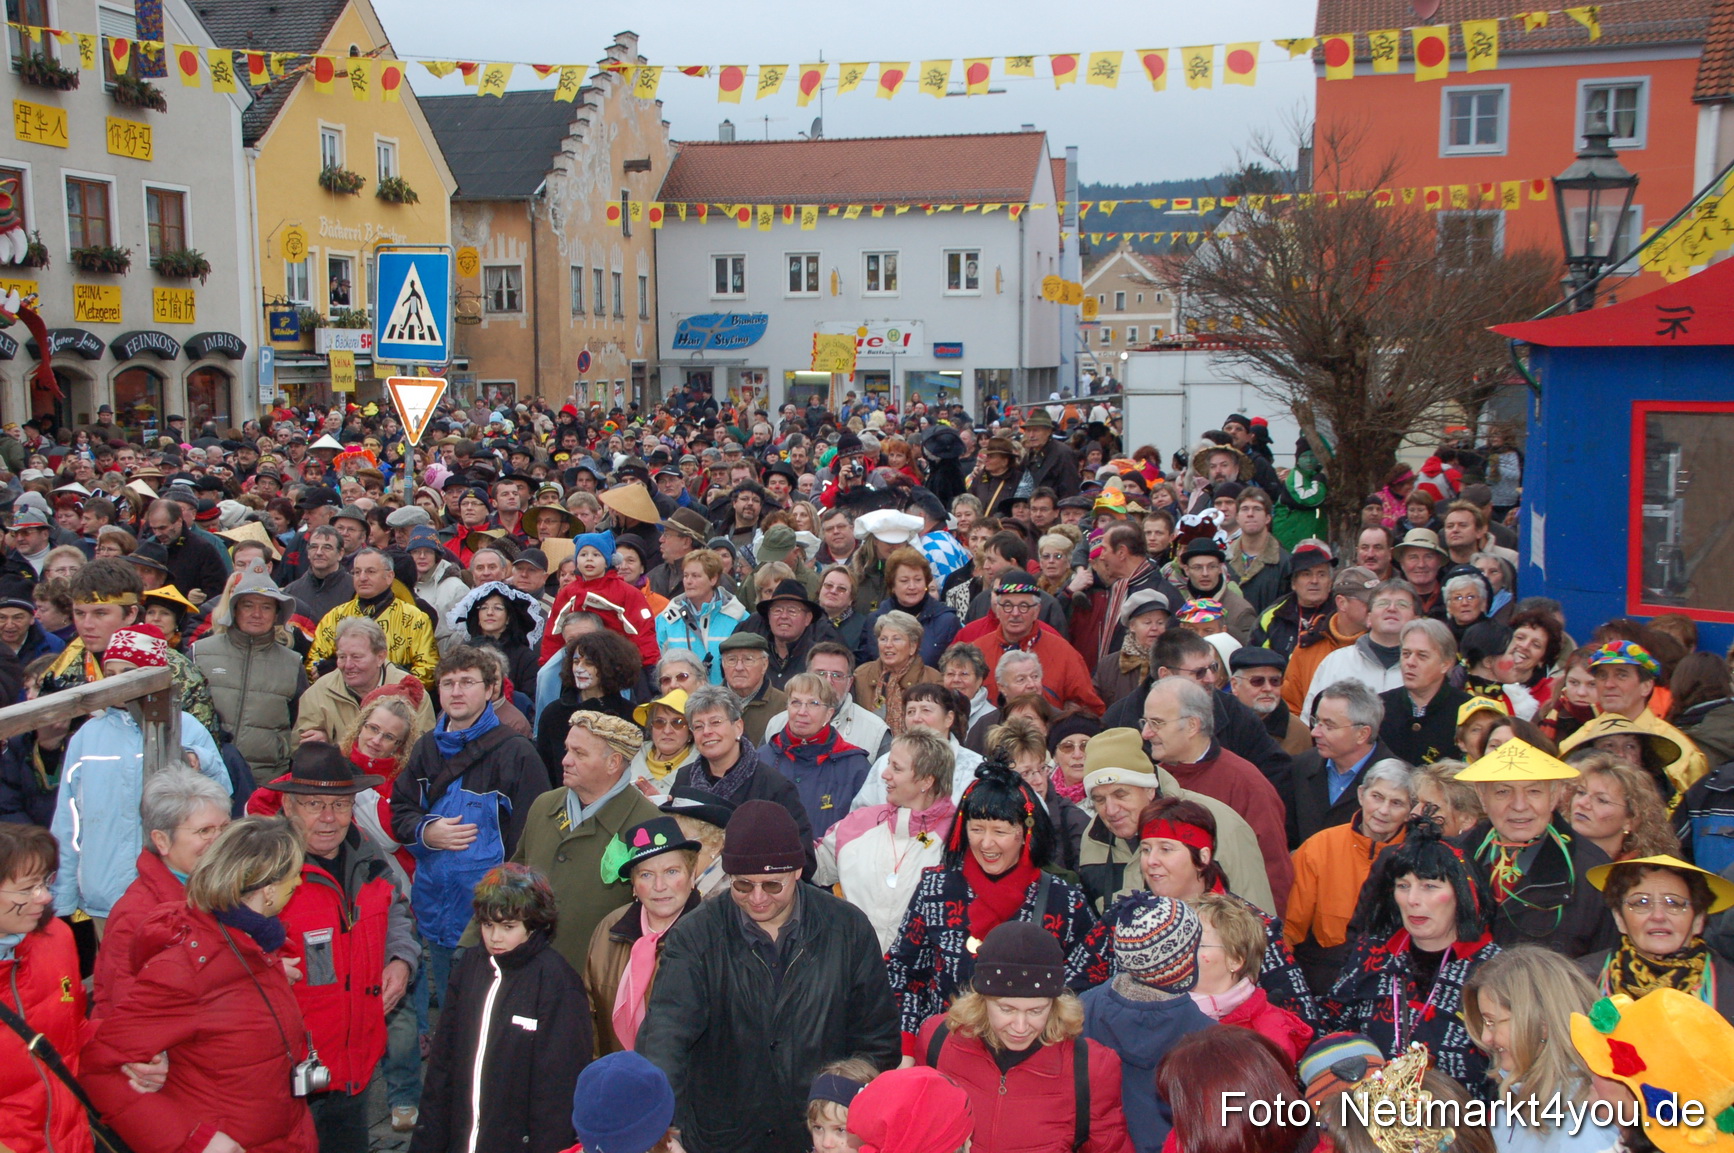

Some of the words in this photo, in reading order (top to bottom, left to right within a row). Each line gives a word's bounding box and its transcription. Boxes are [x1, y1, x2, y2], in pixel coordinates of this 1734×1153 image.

[109, 122, 152, 157] 你好吗
[78, 286, 102, 300] CHINA
[75, 300, 121, 321] Metzgerei
[125, 333, 181, 357] FEINKOST
[203, 335, 240, 352] IMBISS
[335, 334, 360, 349] Bäckerei
[678, 333, 701, 346] Hair
[715, 333, 750, 348] Styling
[261, 350, 271, 373] P
